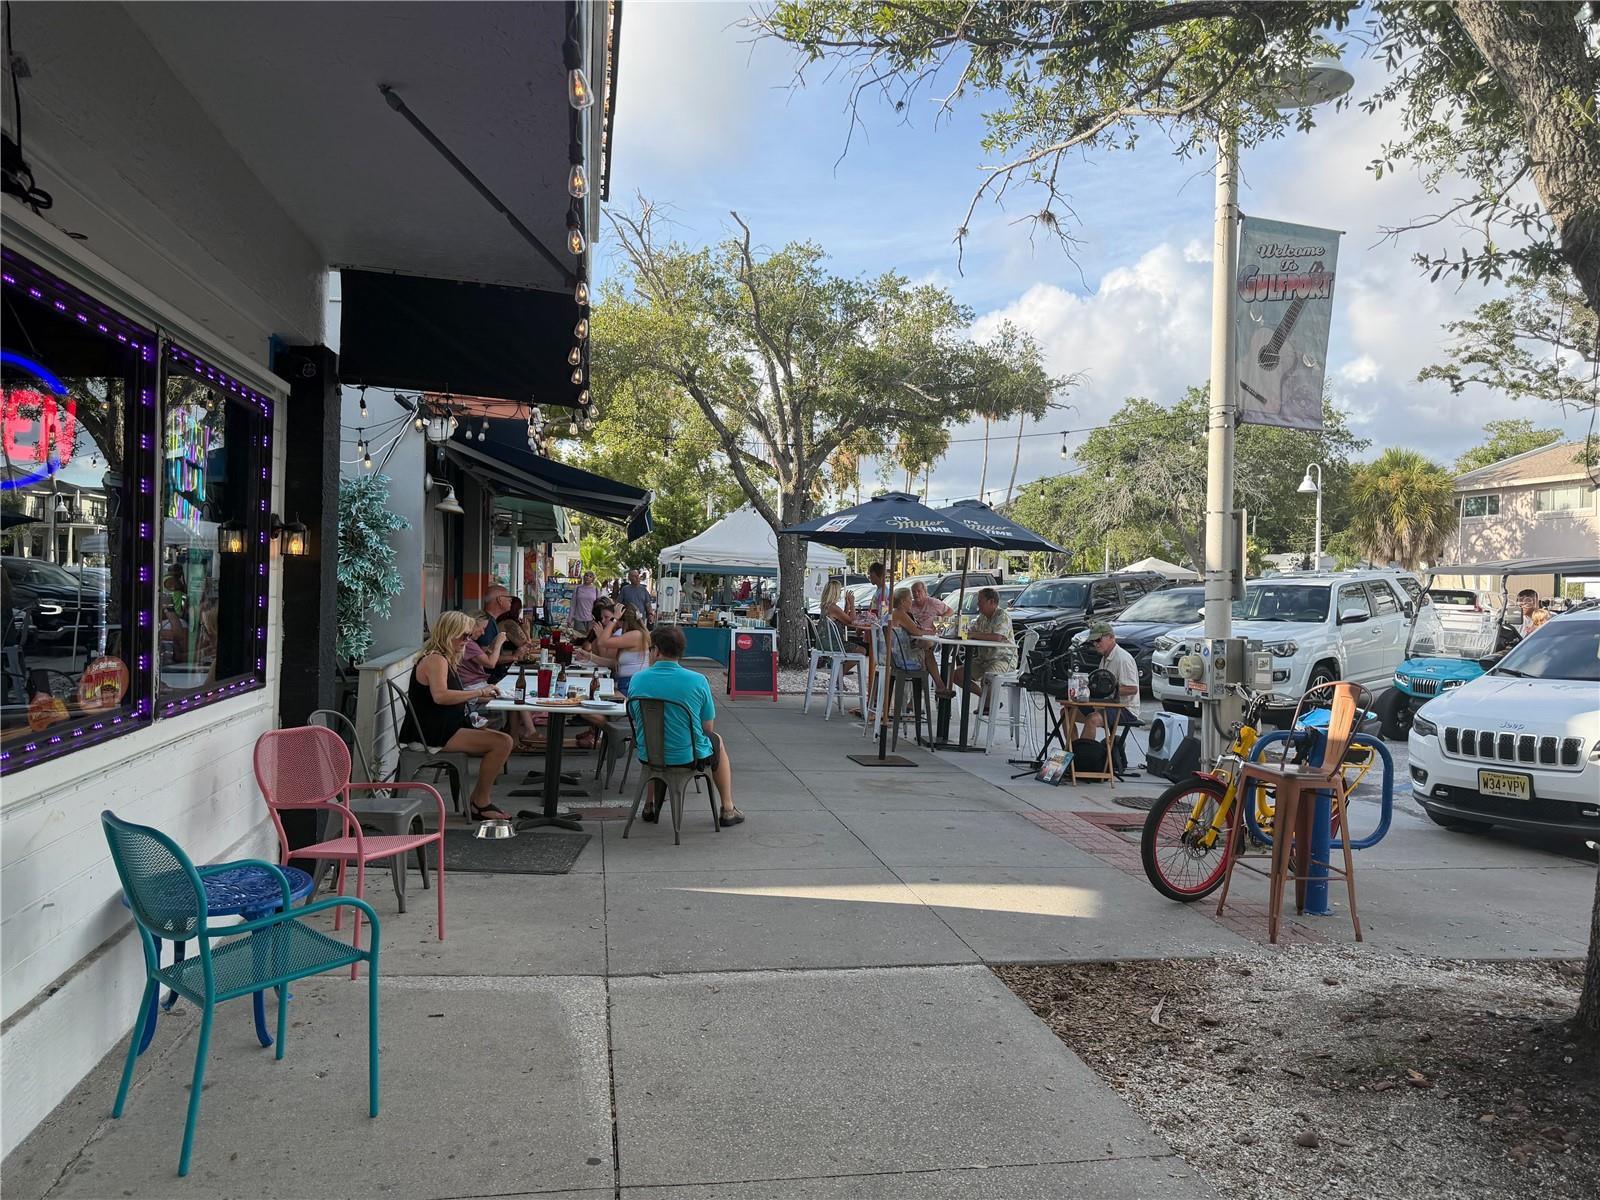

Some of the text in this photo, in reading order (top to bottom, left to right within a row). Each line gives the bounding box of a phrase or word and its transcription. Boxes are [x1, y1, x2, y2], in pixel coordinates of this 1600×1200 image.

[1257, 243, 1325, 259] Welcome
[1280, 259, 1299, 272] To
[1238, 264, 1335, 303] GULFPORT
[0, 388, 77, 469] EN
[885, 519, 945, 530] Miller
[983, 529, 1013, 537] TIME
[1499, 720, 1525, 731] Jeep
